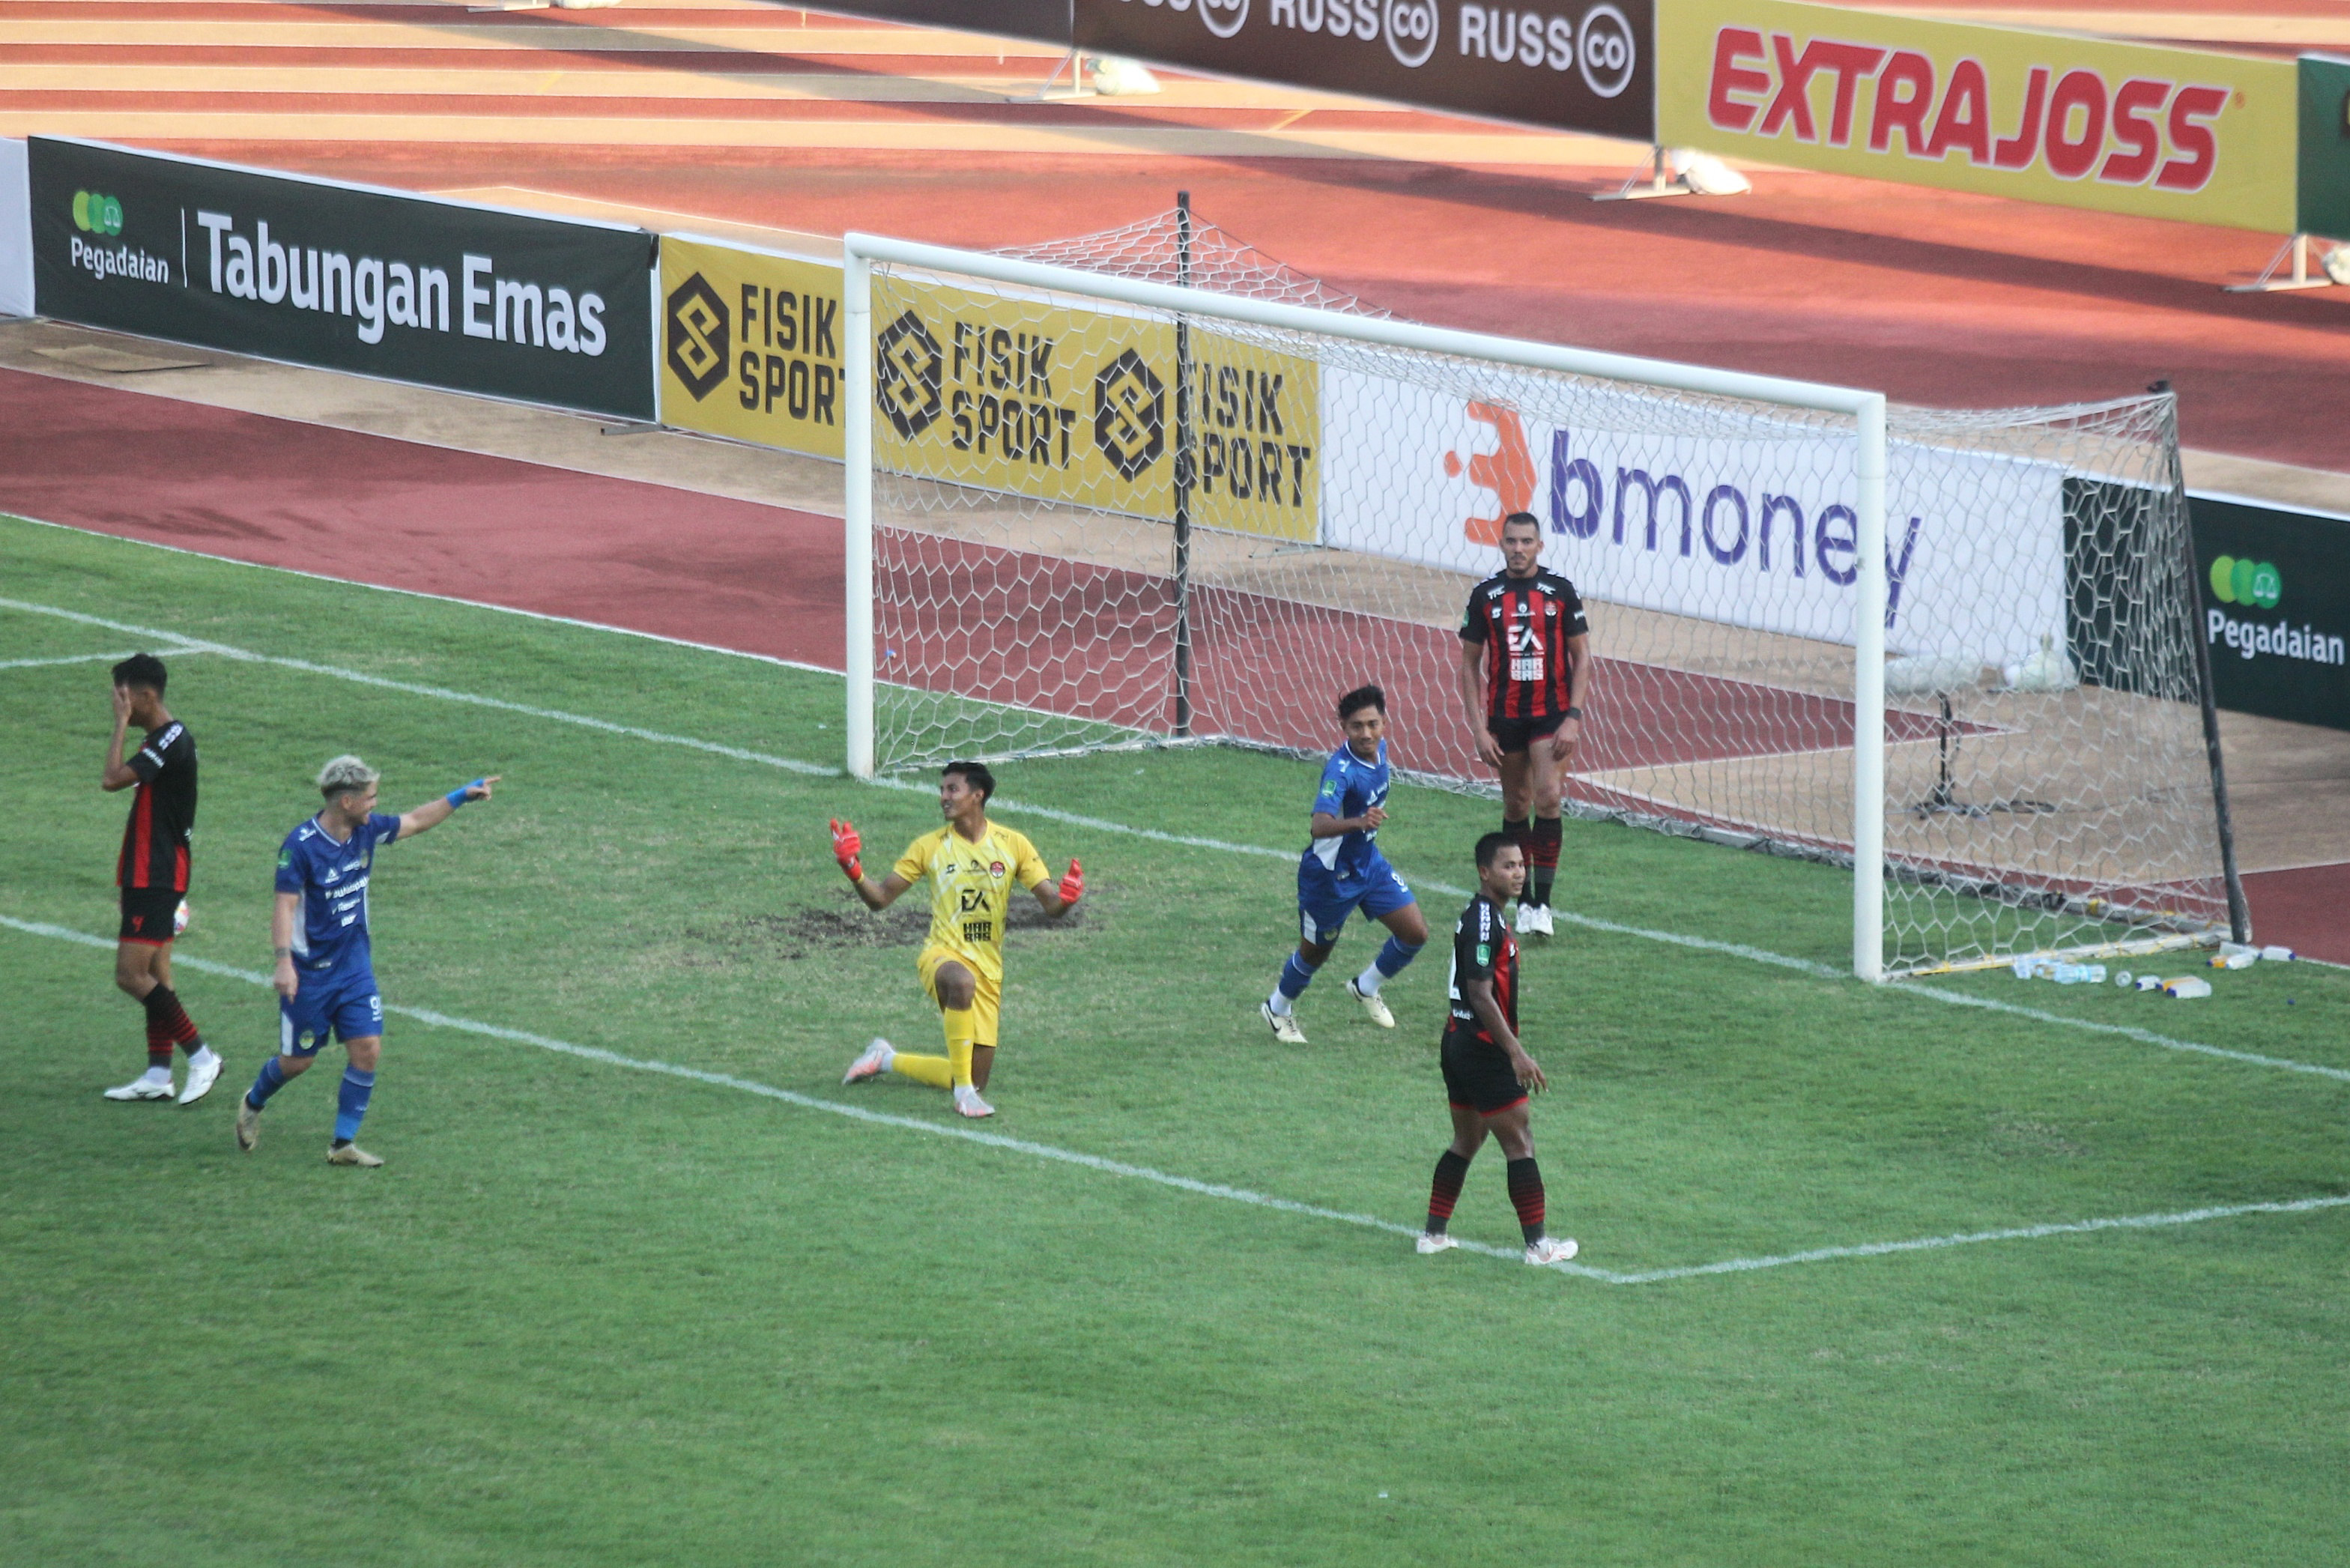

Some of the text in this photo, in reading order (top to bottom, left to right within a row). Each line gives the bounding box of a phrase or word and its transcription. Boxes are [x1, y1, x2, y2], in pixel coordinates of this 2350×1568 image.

[1459, 6, 1573, 71] RUSS
[70, 236, 170, 285] Pegadaian
[198, 211, 608, 357] Tabungan Emas
[742, 283, 837, 360] FISIK
[954, 321, 1053, 399] FISIK
[739, 351, 845, 426] SPOR
[952, 390, 1076, 470] SPORT
[1551, 429, 1922, 629] bmoney
[2208, 609, 2346, 665] Pegadaian
